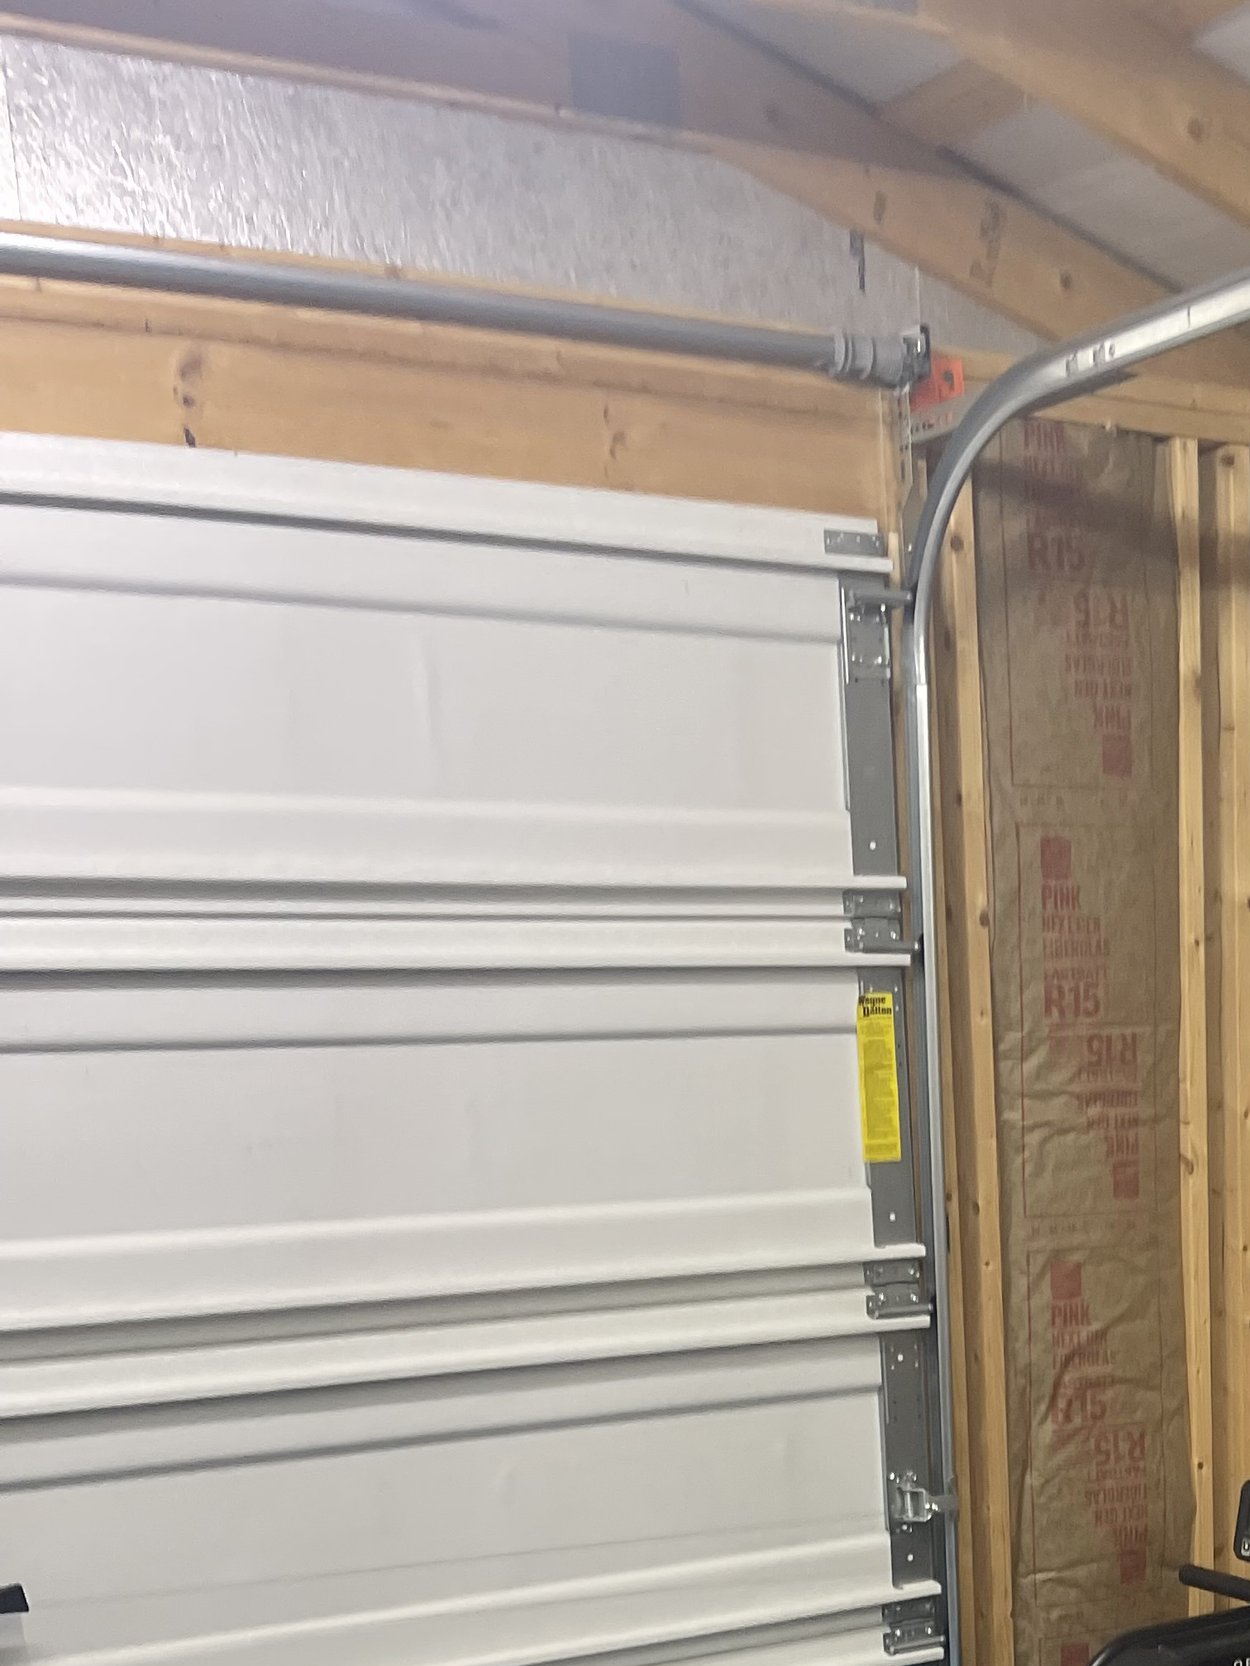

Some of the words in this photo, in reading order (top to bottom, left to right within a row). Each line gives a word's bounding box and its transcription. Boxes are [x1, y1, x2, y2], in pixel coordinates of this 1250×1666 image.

[1041, 884, 1080, 910] PINK
[1044, 982, 1100, 1018] R15
[1087, 1033, 1139, 1067] R15
[1051, 1302, 1091, 1327] PINK
[1094, 1431, 1146, 1464] R15
